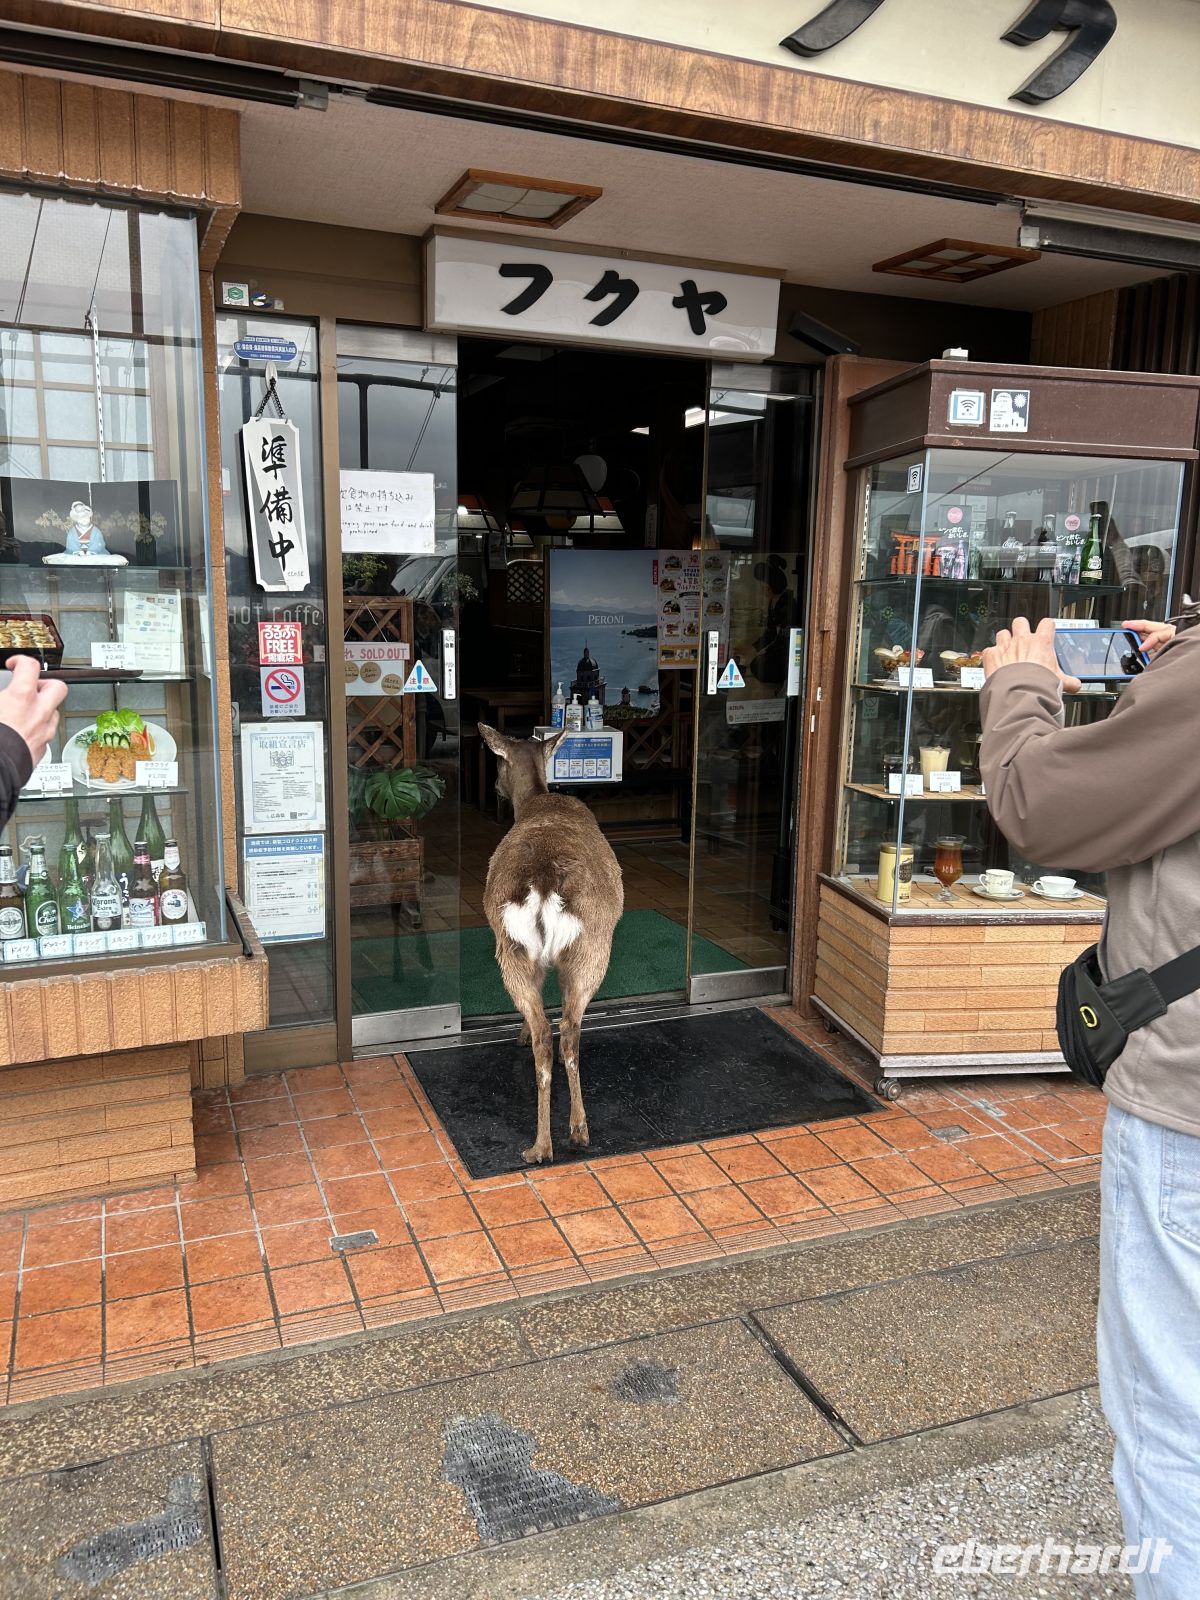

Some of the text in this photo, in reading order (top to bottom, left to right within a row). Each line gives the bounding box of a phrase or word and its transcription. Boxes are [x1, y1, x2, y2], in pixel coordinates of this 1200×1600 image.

[498, 263, 728, 336] フクヤ
[259, 434, 295, 572] 準備中
[228, 602, 263, 625] HOT
[588, 614, 625, 625] PERONI
[264, 624, 296, 640] るるぶ
[266, 639, 295, 653] FREE
[360, 648, 385, 660] SOLD
[387, 648, 407, 659] OUT
[259, 739, 308, 750] 取組宣言店
[92, 898, 117, 906] Corona
[146, 932, 168, 941] アメリカ
[11, 945, 31, 954] ドイツ
